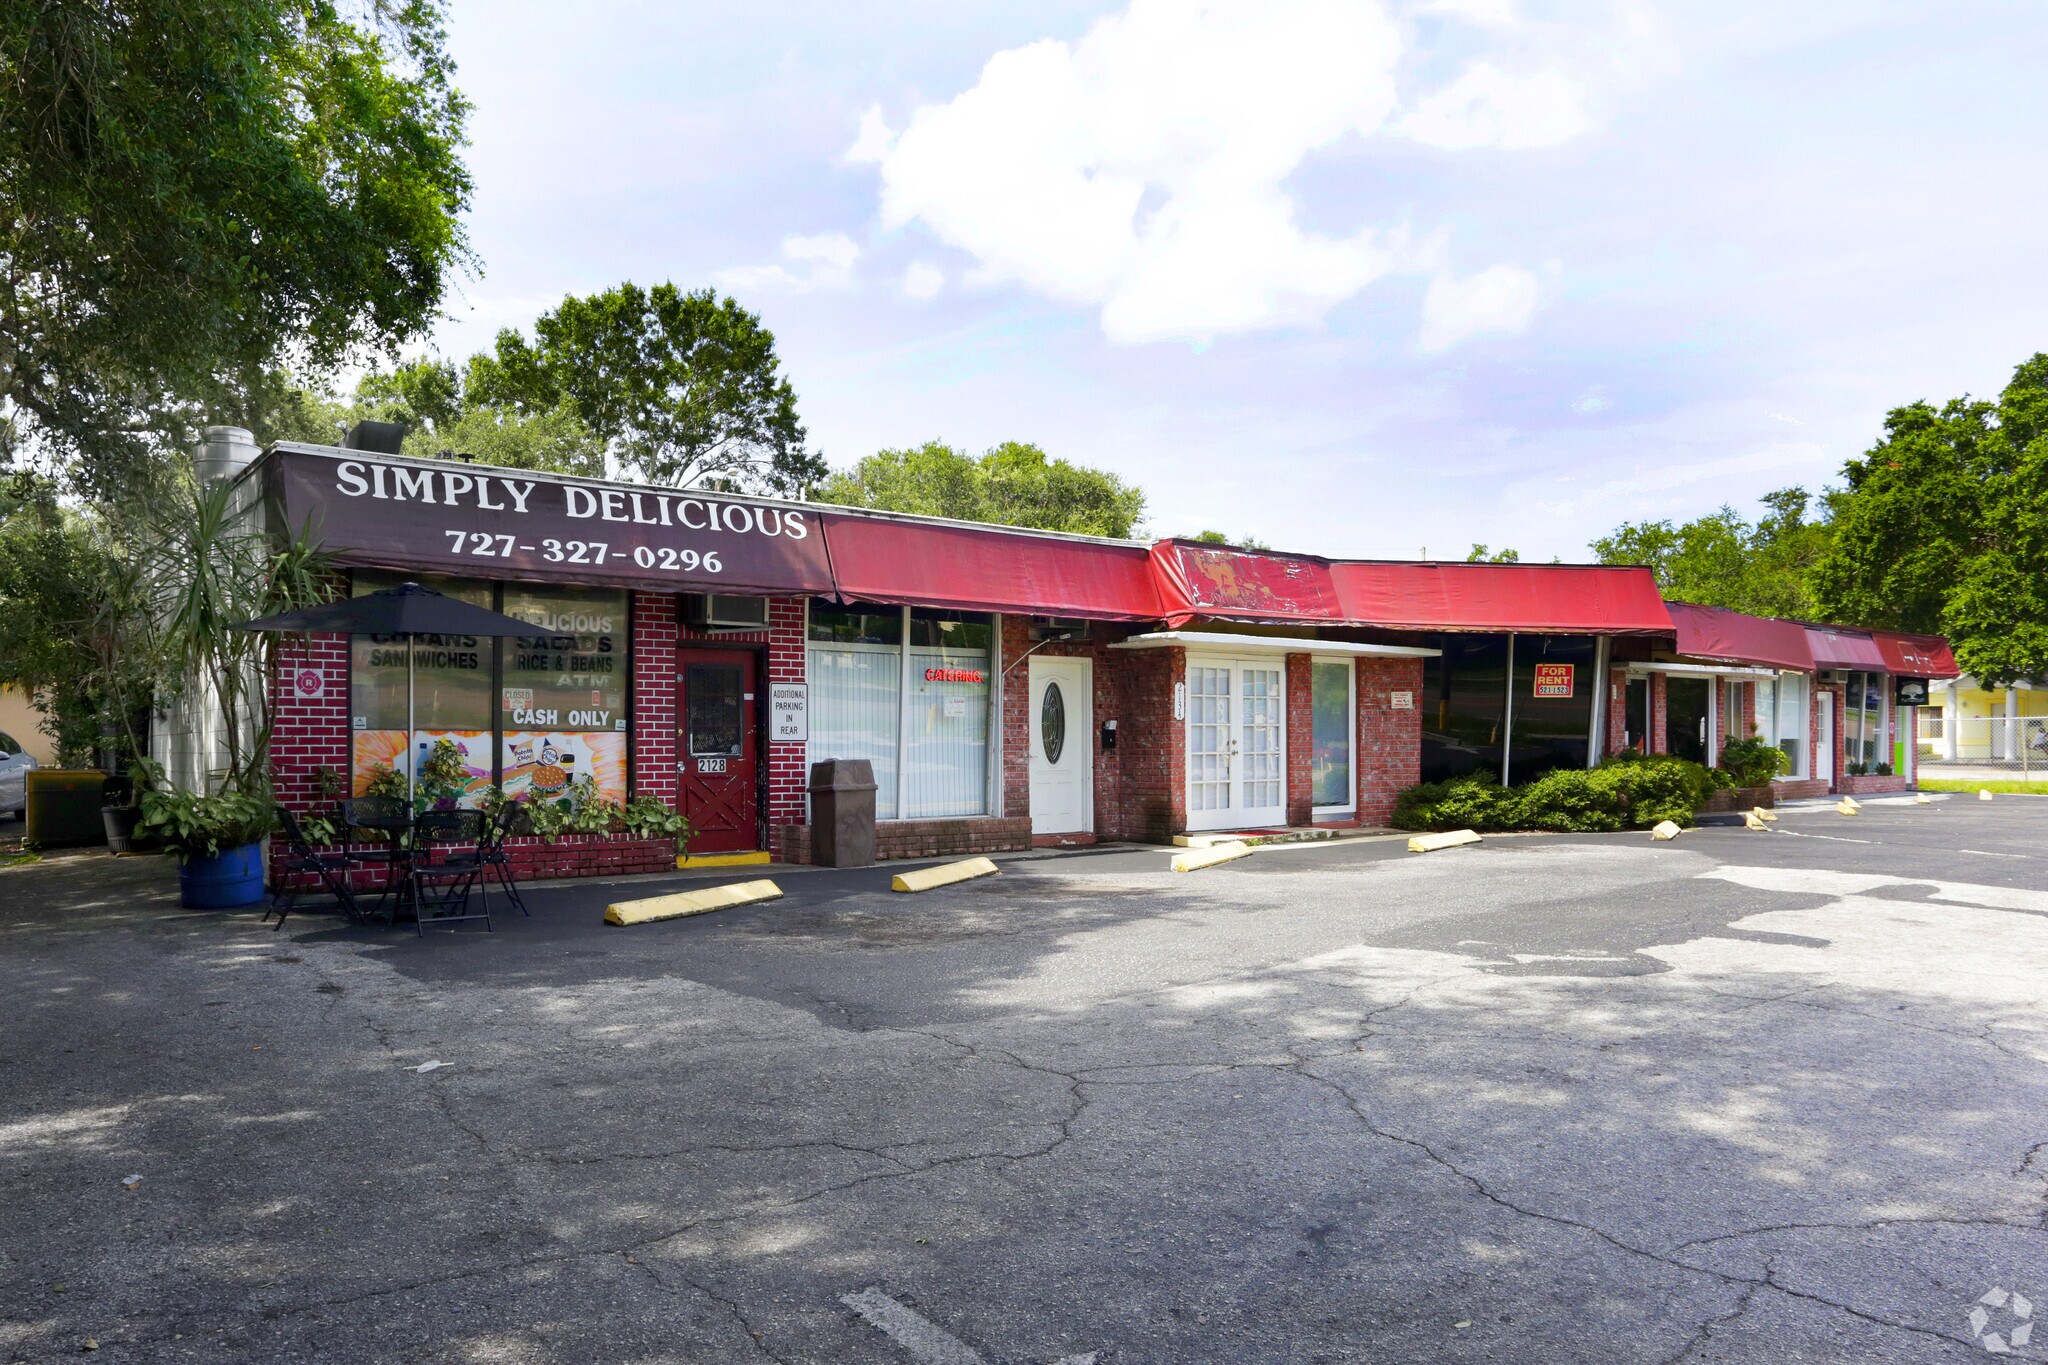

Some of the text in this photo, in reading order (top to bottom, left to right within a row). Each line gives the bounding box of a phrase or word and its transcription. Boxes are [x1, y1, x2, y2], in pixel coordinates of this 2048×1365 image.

[336, 461, 808, 540] SIMPLY DELICIOUS
[445, 530, 723, 573] 727-327-0296
[517, 653, 613, 673] RICE & BEANS
[925, 669, 983, 683] CATERING
[1542, 667, 1567, 676] FOR
[556, 673, 611, 687] ATM
[1537, 676, 1570, 685] RENT
[504, 690, 530, 700] CLOSED
[773, 689, 806, 699] ADDITIONAL
[775, 701, 803, 711] PARKING
[513, 708, 609, 726] CASH ONLY
[786, 714, 793, 722] IN
[780, 725, 799, 735] REAR
[699, 759, 725, 772] 2128
